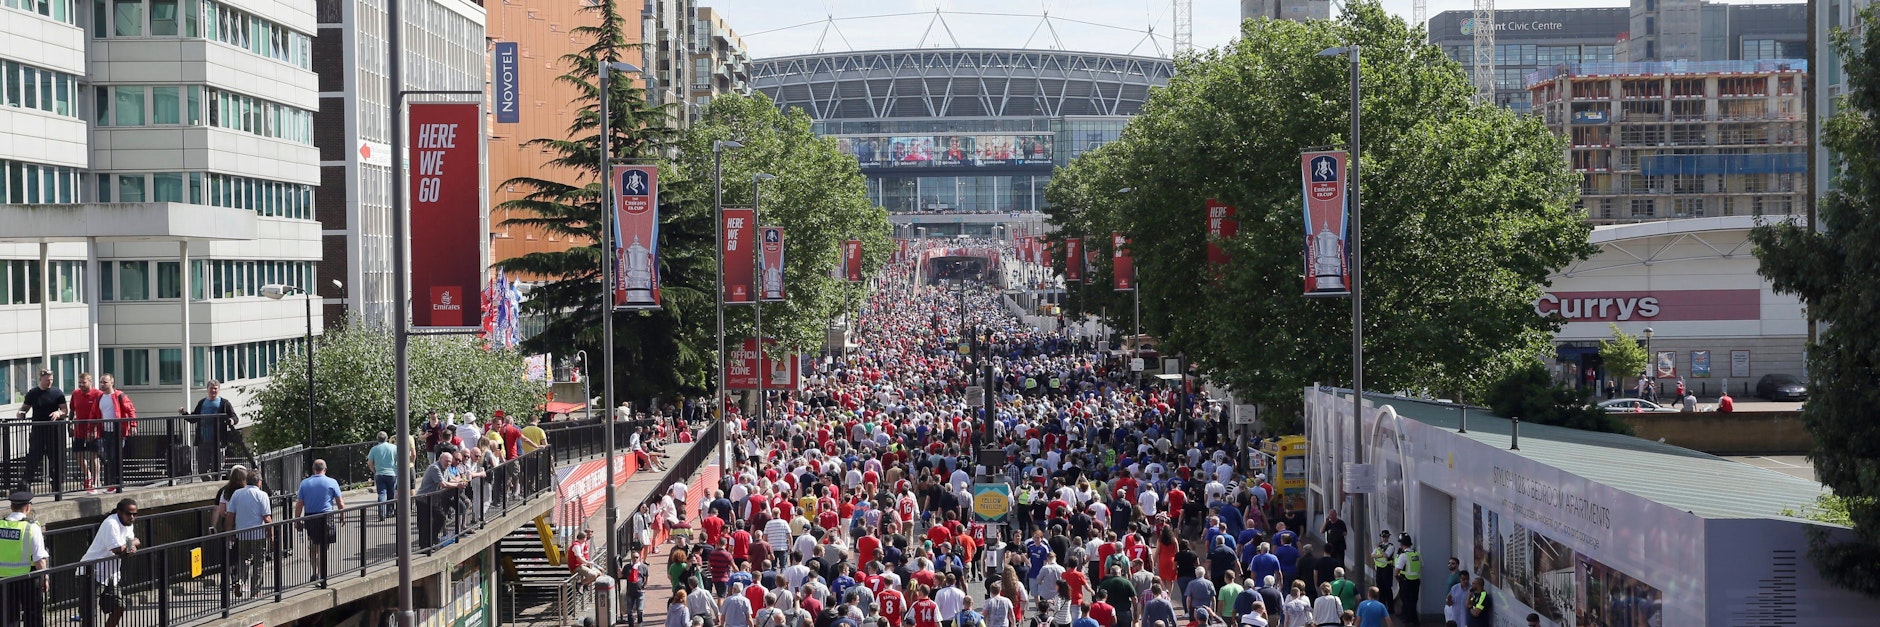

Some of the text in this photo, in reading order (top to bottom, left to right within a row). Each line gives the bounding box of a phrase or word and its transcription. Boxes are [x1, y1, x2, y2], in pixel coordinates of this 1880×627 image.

[1479, 21, 1562, 31] Brnt Civic Centre
[502, 47, 513, 112] NOVOTEL
[418, 123, 458, 149] HERE
[419, 151, 445, 176] WE
[418, 177, 441, 203] GO
[1210, 206, 1227, 218] HERE
[727, 218, 744, 229] HERE
[1211, 218, 1221, 229] WE
[727, 229, 739, 240] WE
[727, 240, 737, 251] GO
[433, 303, 461, 311] Emirates
[1534, 292, 1660, 321] Currys
[730, 359, 746, 367] FN
[730, 367, 751, 376] ZONE
[806, 502, 813, 511] 16
[903, 503, 912, 513] 16
[1531, 480, 1564, 510] BEDROOM
[1566, 493, 1610, 530] APARTMENTS
[0, 529, 19, 539] POLICE
[1135, 547, 1143, 559] 7
[840, 585, 847, 597] 5
[870, 578, 880, 592] 7
[885, 600, 894, 615] 8
[920, 608, 932, 621] 14
